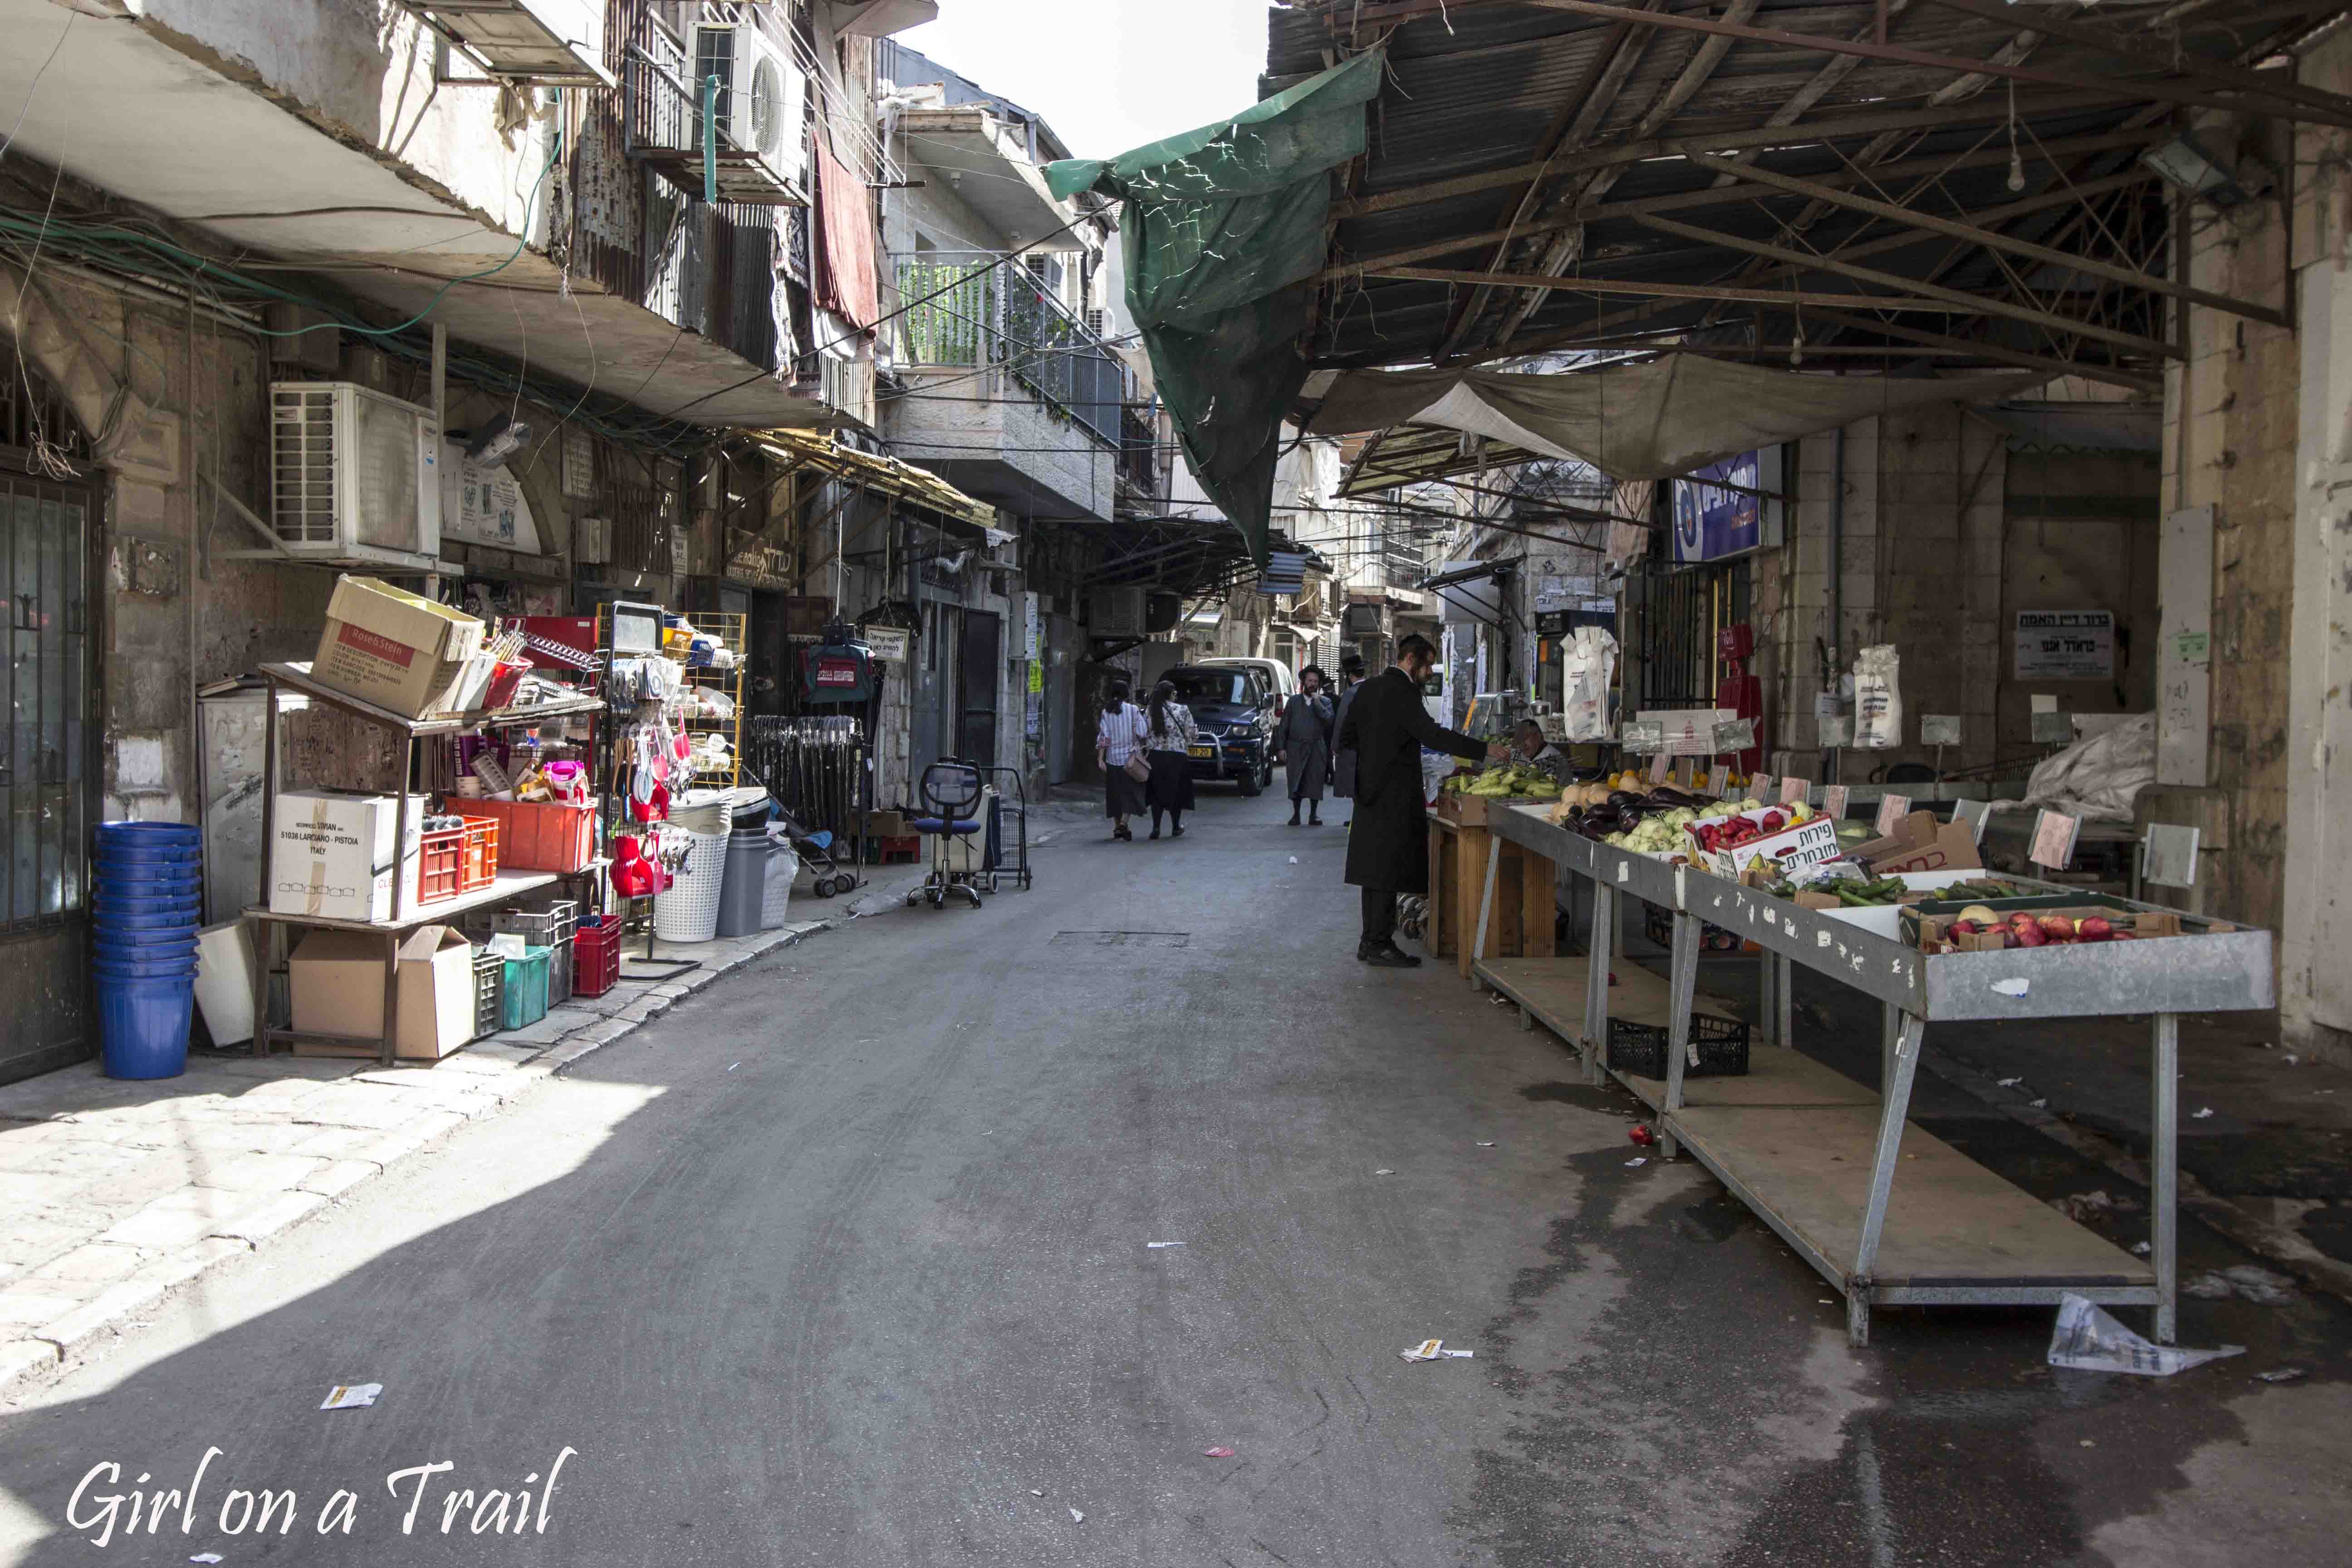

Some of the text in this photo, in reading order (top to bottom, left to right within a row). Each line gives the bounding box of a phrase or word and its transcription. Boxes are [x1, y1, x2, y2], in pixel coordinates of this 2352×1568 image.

[317, 822, 337, 832] VIVIAN
[281, 831, 299, 840] 51036
[299, 833, 330, 843] LARCIANO
[334, 836, 359, 845] PISTOIA
[1798, 823, 1833, 847] פירות
[310, 847, 326, 855] ITALY
[1786, 842, 1837, 870] מובחרים
